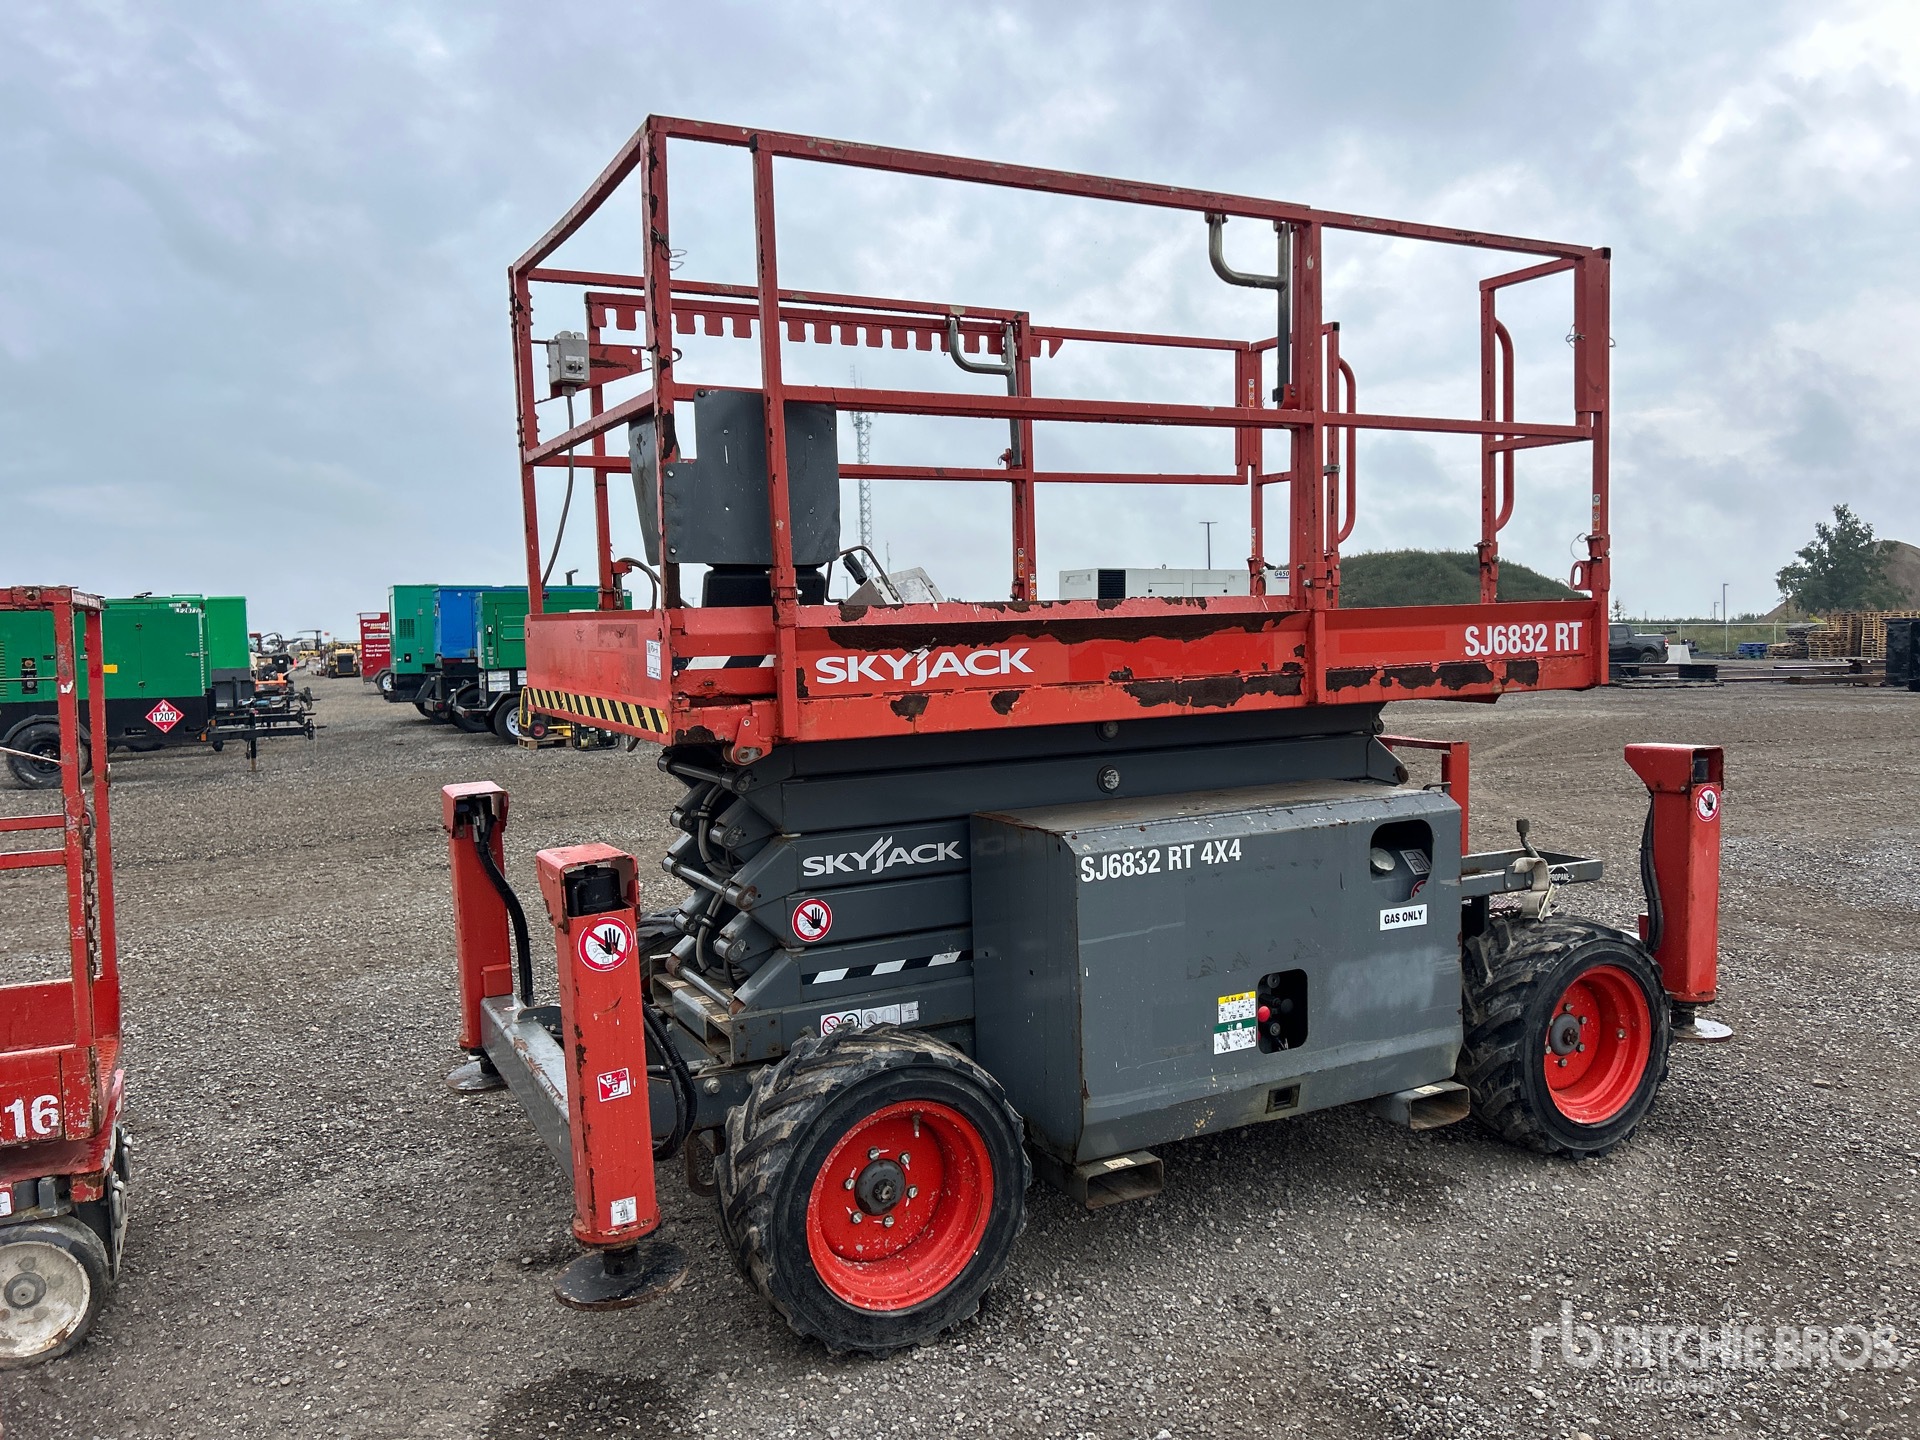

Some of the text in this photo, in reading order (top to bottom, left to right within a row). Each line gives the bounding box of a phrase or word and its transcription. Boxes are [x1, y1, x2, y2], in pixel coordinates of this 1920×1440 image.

[1465, 622, 1582, 656] SJ6832 RT
[815, 646, 1034, 686] SKYJACK
[154, 712, 176, 721] 1202
[802, 836, 963, 877] SKYJACK
[1080, 838, 1242, 883] SJ6832 RT 4X4
[1384, 910, 1423, 925] GAS ONLY
[4, 1094, 59, 1138] 16
